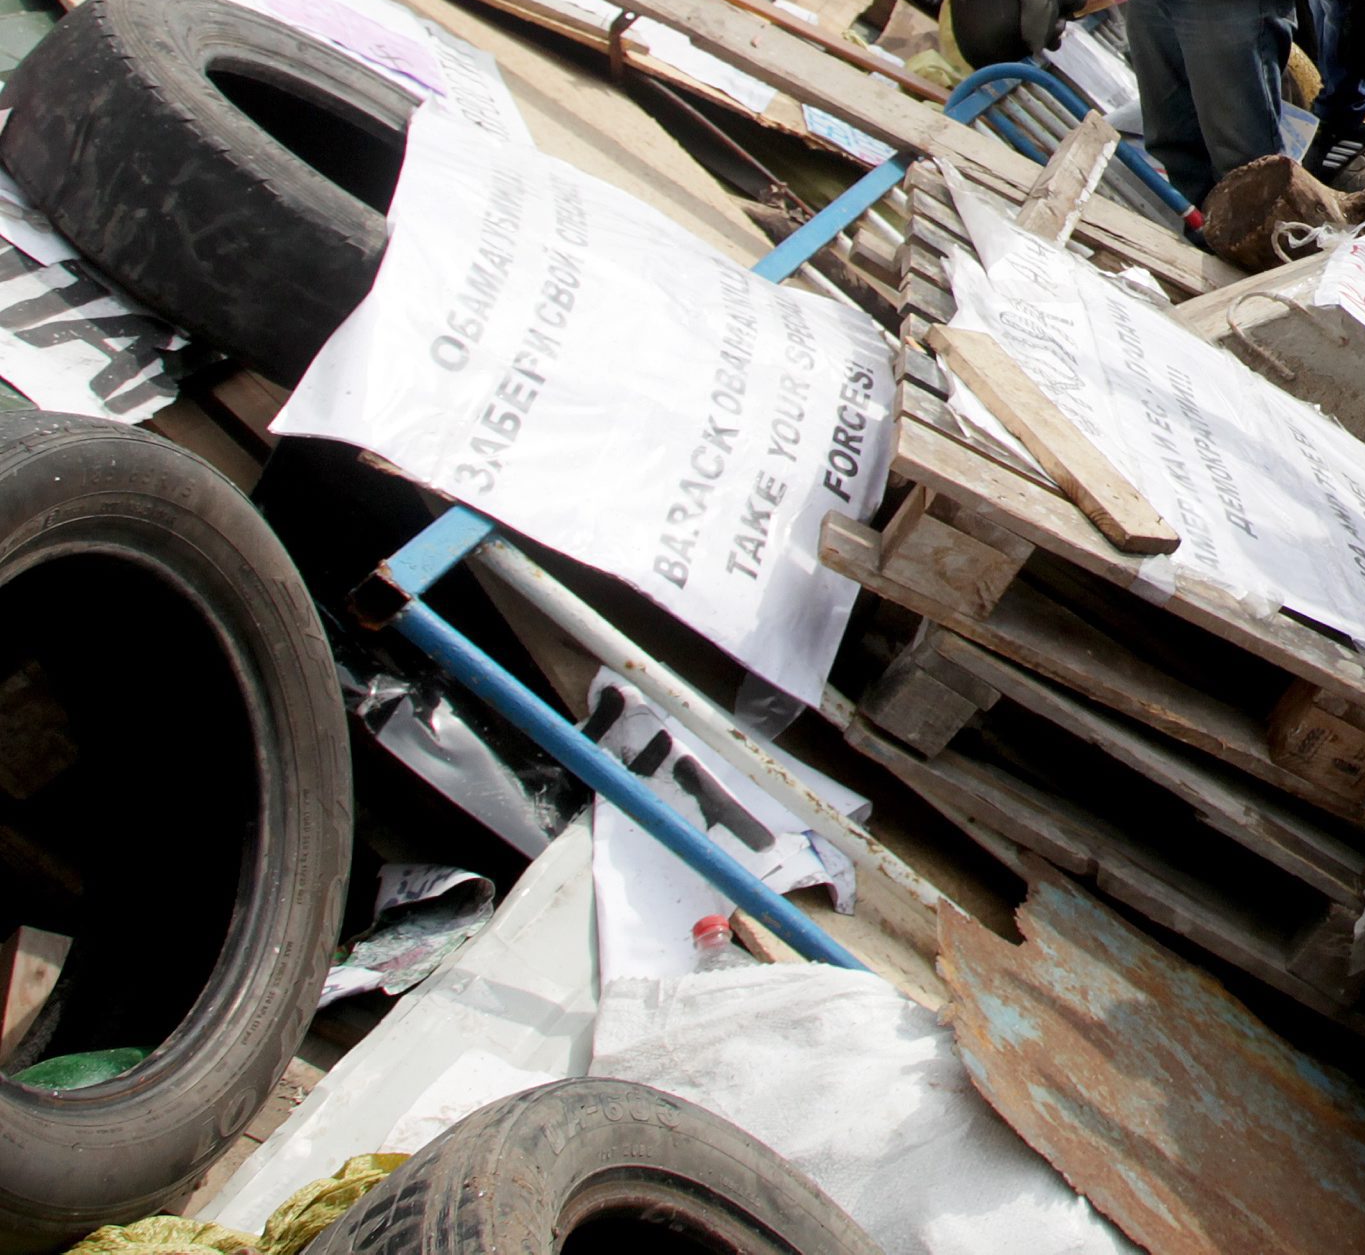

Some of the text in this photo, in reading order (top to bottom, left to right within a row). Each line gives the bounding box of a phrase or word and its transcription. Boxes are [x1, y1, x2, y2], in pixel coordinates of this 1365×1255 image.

[455, 324, 562, 495] ЗАБЕРИ
[724, 469, 788, 583] TAKE
[767, 373, 811, 463] YOUR
[822, 360, 875, 503] FORCES!
[653, 414, 740, 590] BARACK
